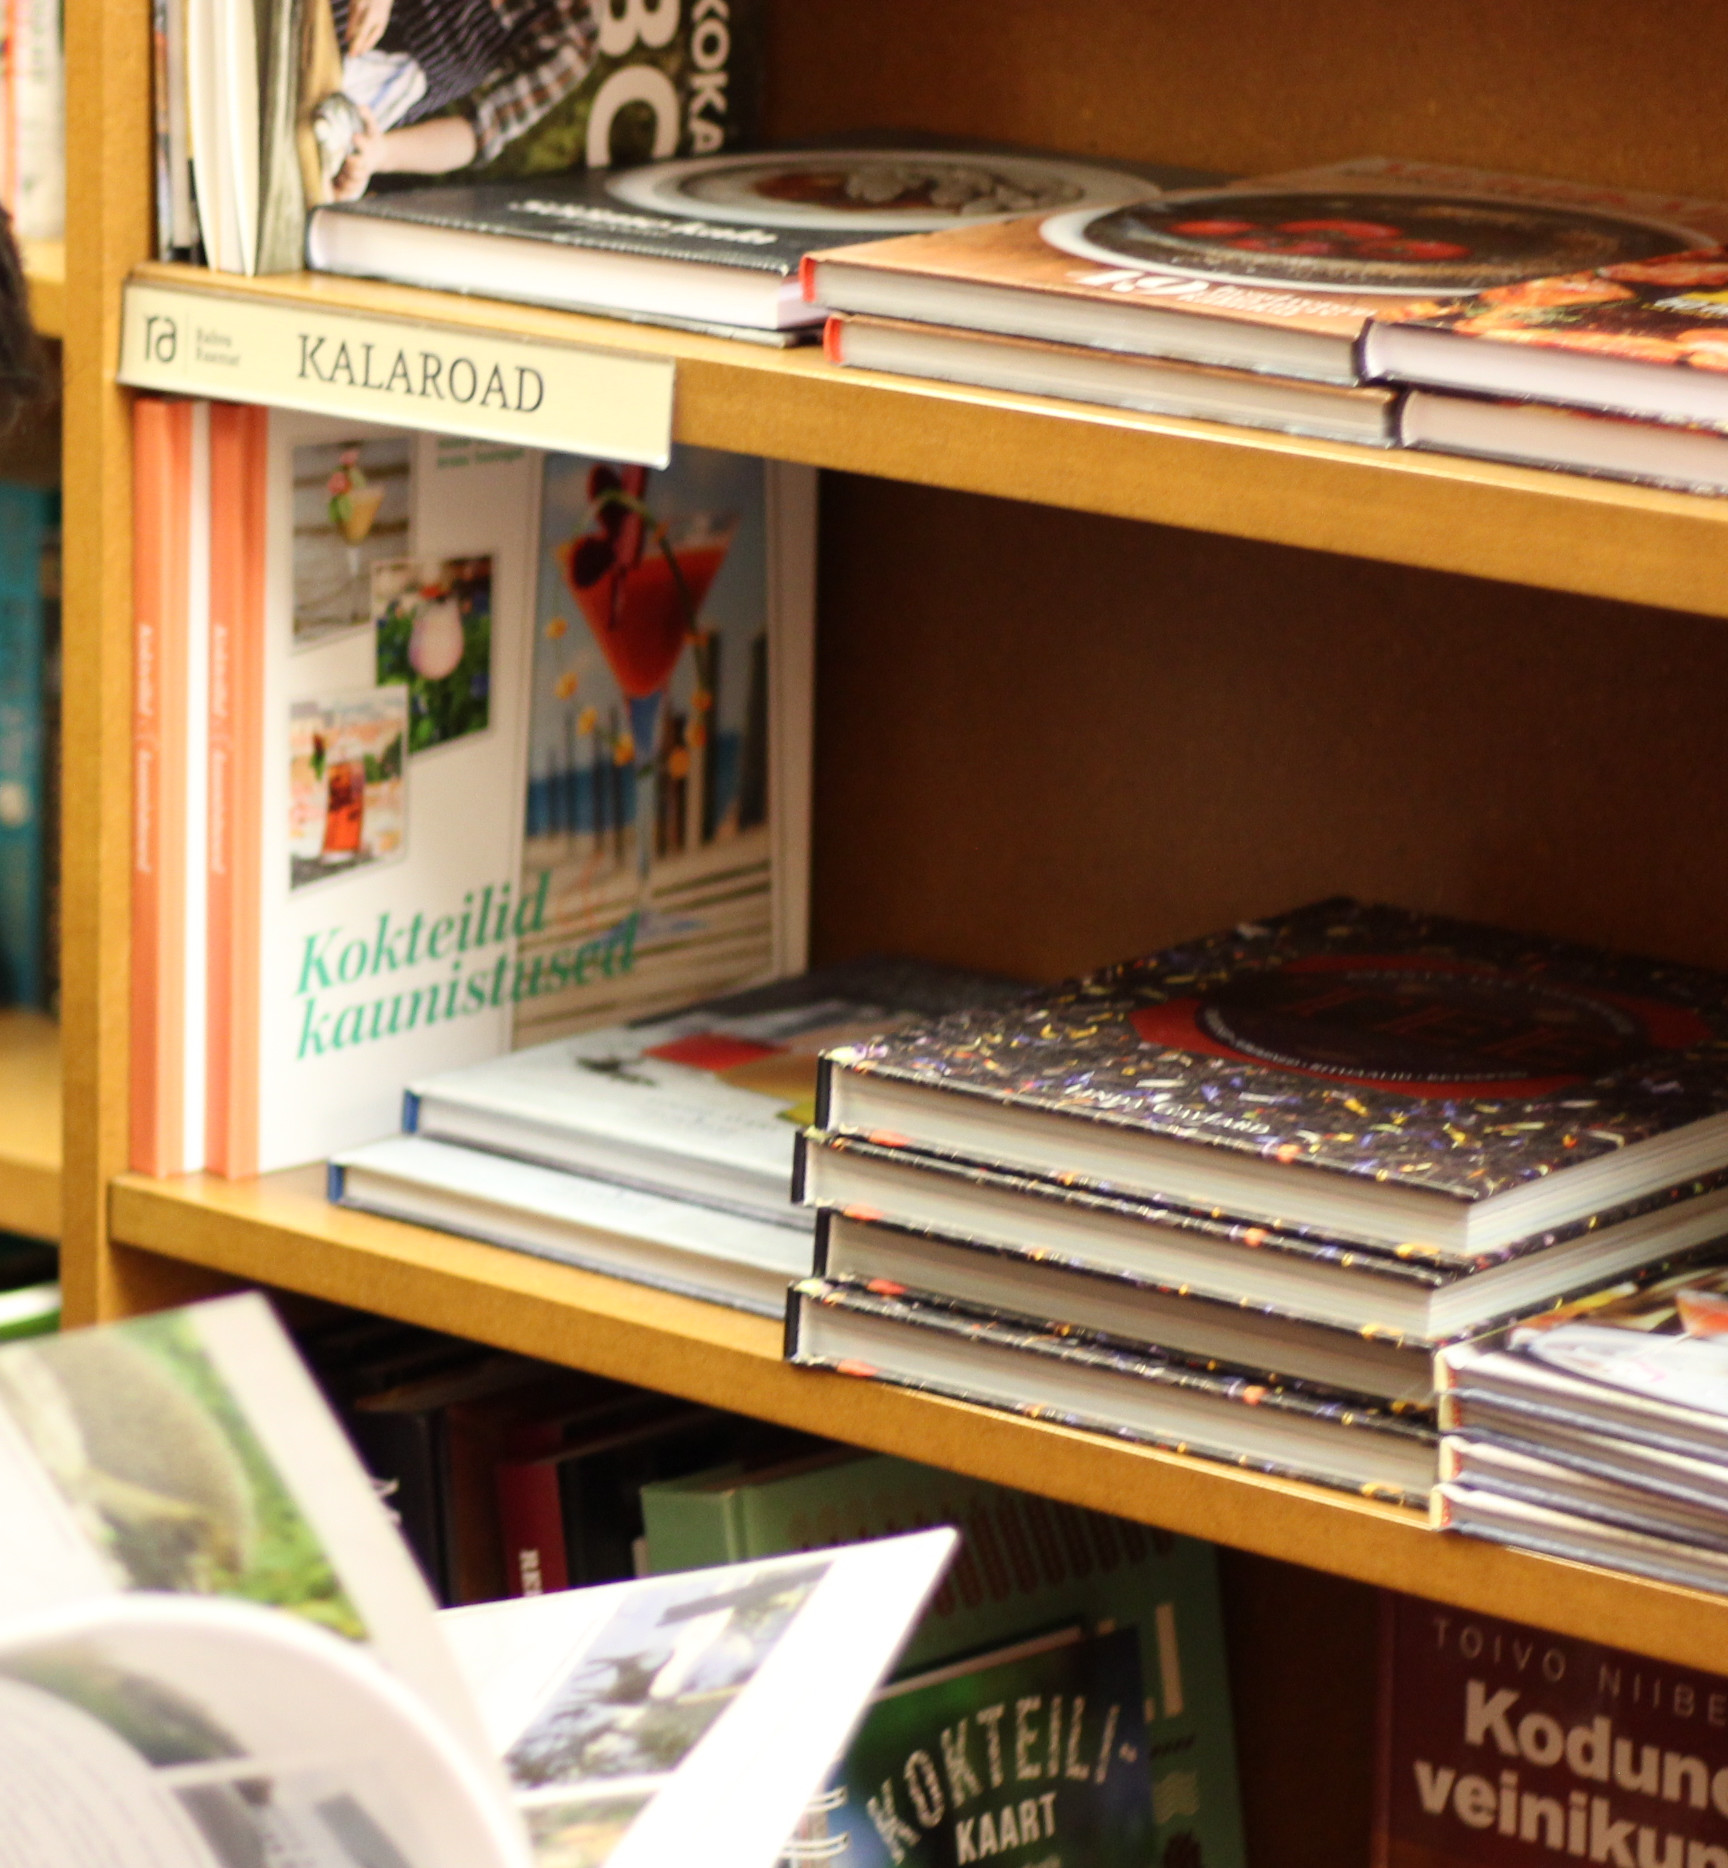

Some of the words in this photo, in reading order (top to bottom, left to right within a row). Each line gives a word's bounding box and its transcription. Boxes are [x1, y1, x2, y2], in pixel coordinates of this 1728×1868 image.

[297, 333, 545, 414] KALAROAD
[295, 869, 553, 997] Kokteilid
[296, 909, 641, 1062] kaunistused
[1434, 1615, 1567, 1684] TOIVO
[954, 1791, 1057, 1867] KAART
